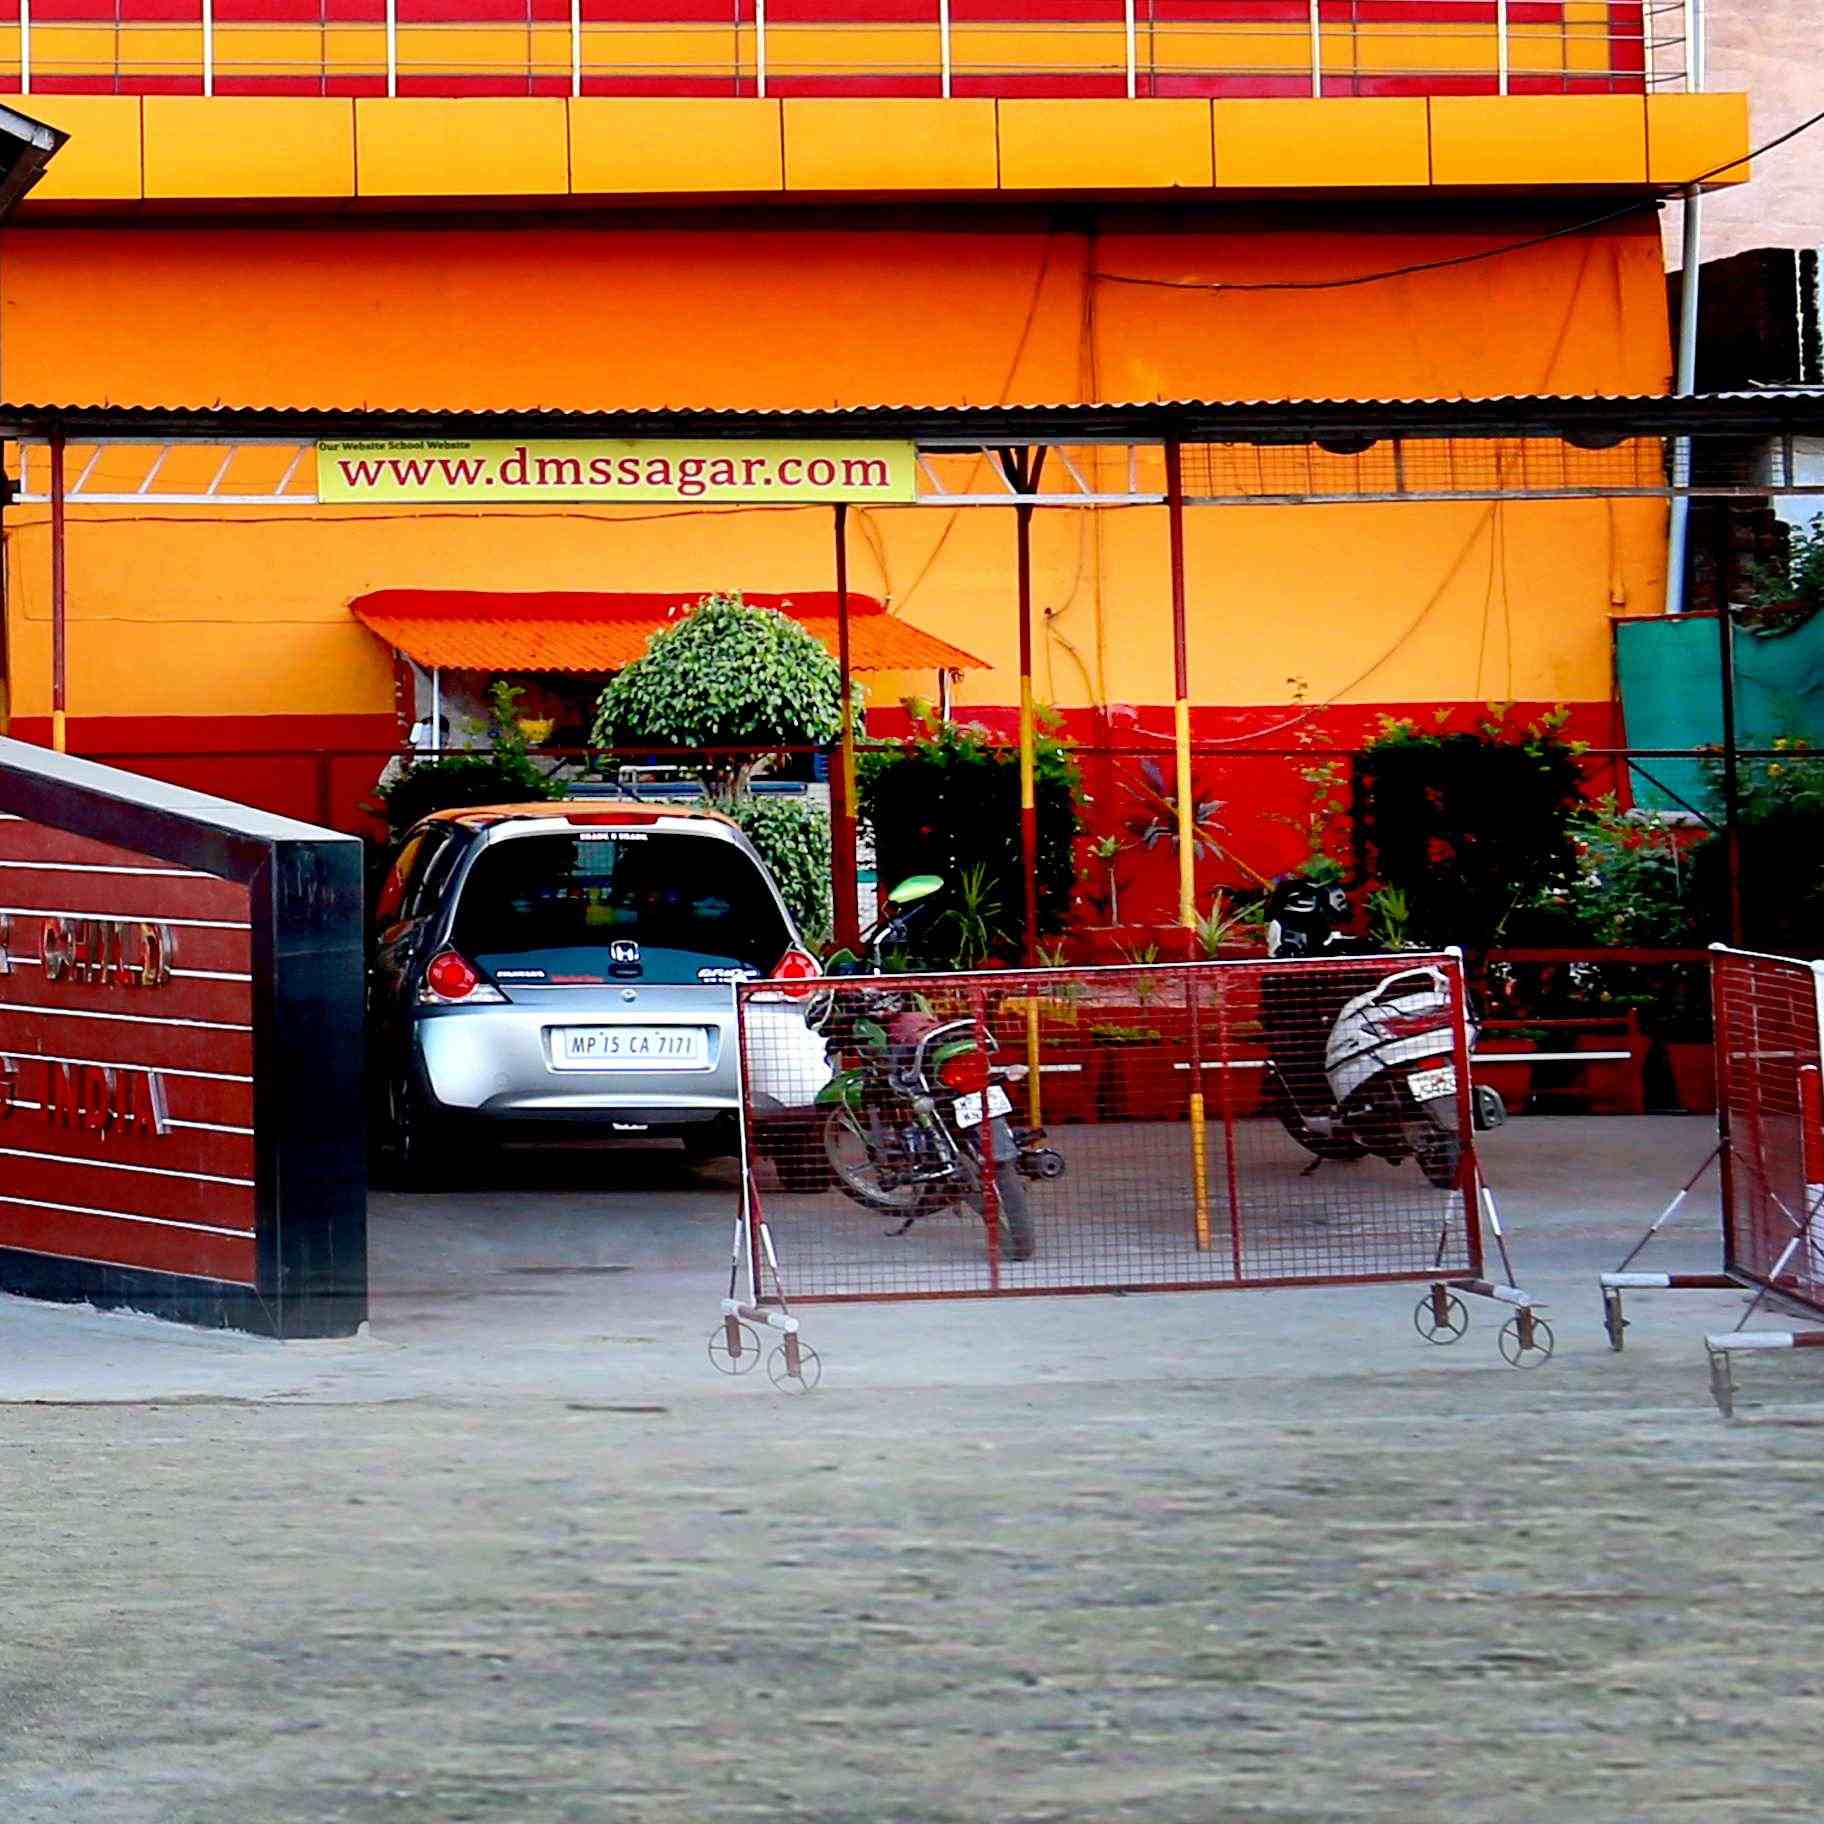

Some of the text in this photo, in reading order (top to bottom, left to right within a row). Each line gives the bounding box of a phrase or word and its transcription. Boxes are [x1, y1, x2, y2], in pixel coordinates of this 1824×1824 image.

[337, 447, 891, 495] www.dmssagar.com
[571, 1037, 596, 1053] MP
[629, 1036, 650, 1053] CA
[658, 1036, 692, 1053] 7171
